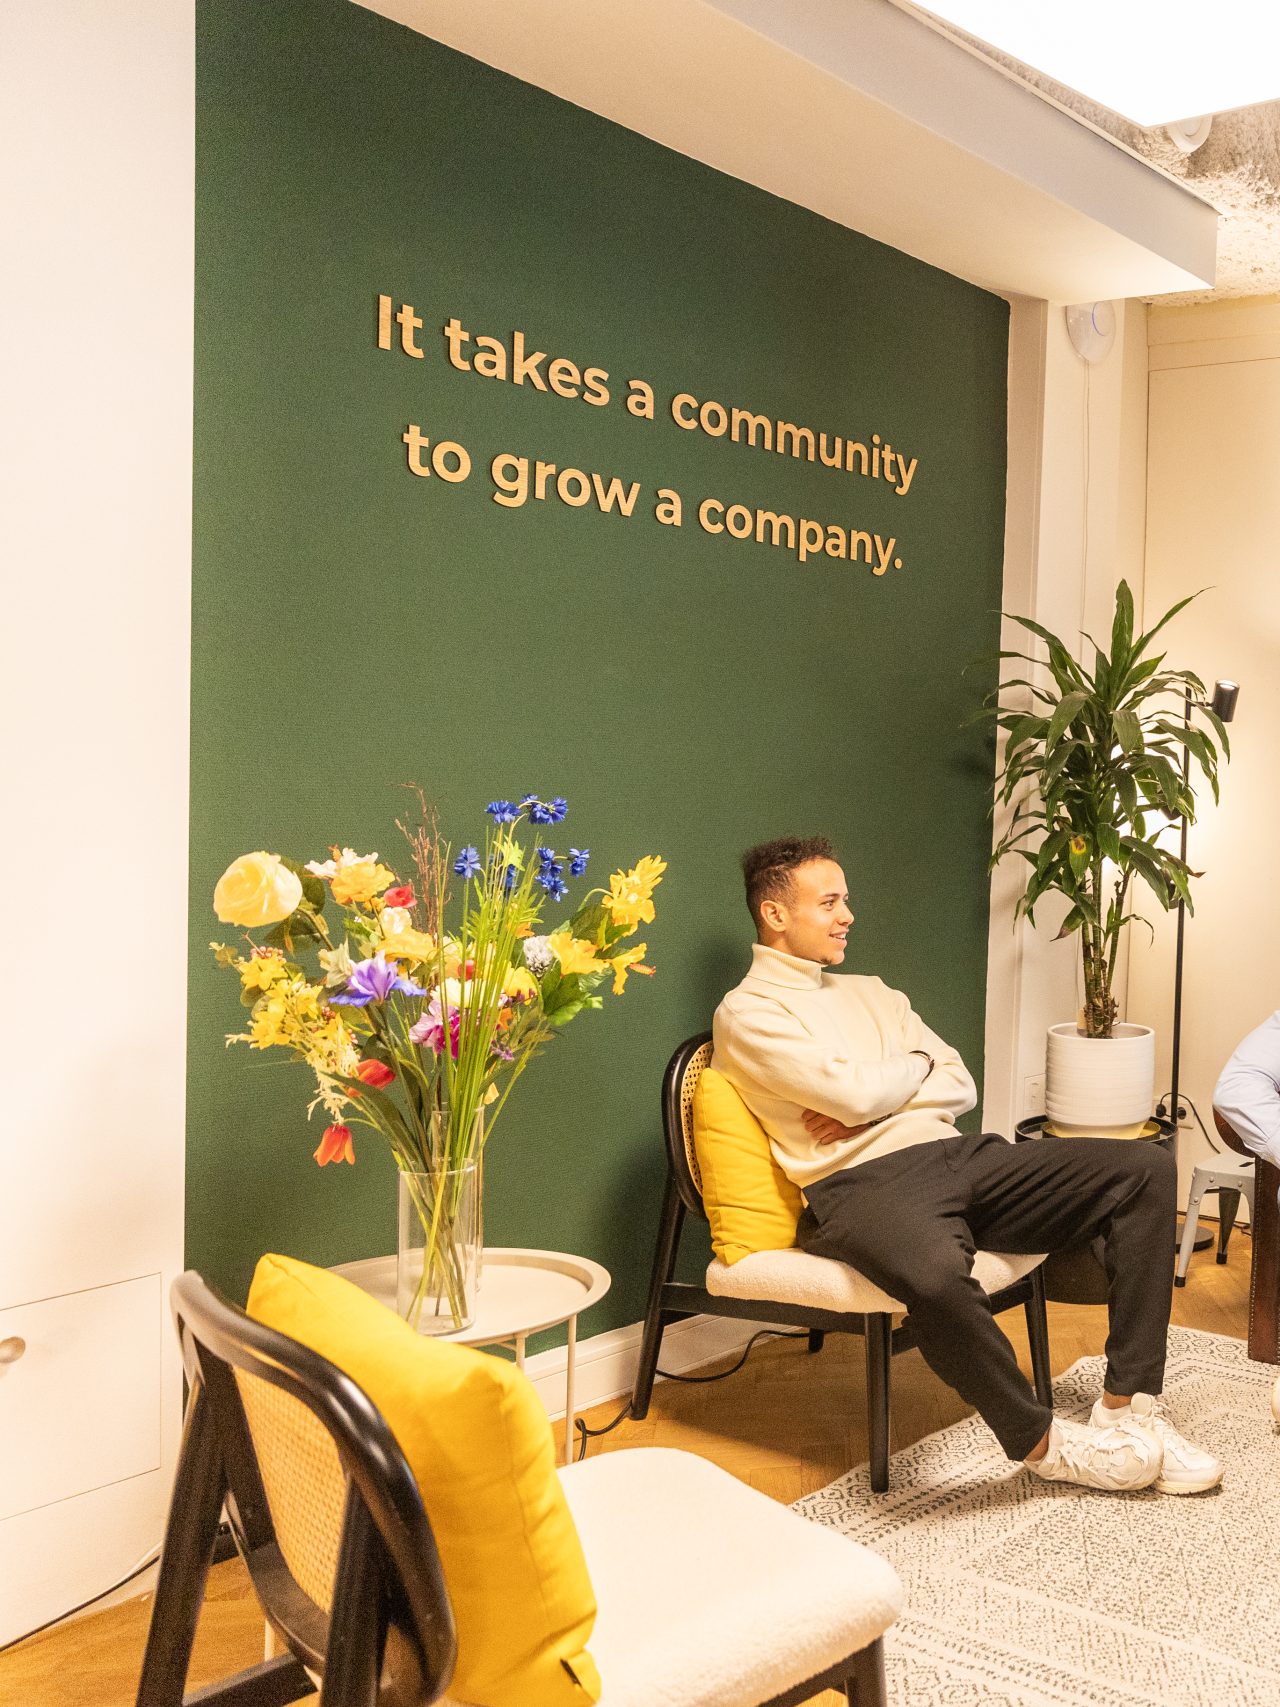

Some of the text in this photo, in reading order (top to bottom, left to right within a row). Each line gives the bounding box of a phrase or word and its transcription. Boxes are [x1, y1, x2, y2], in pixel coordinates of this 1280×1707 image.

[377, 293, 919, 496] It takes a community
[402, 423, 904, 577] to grow a company.
